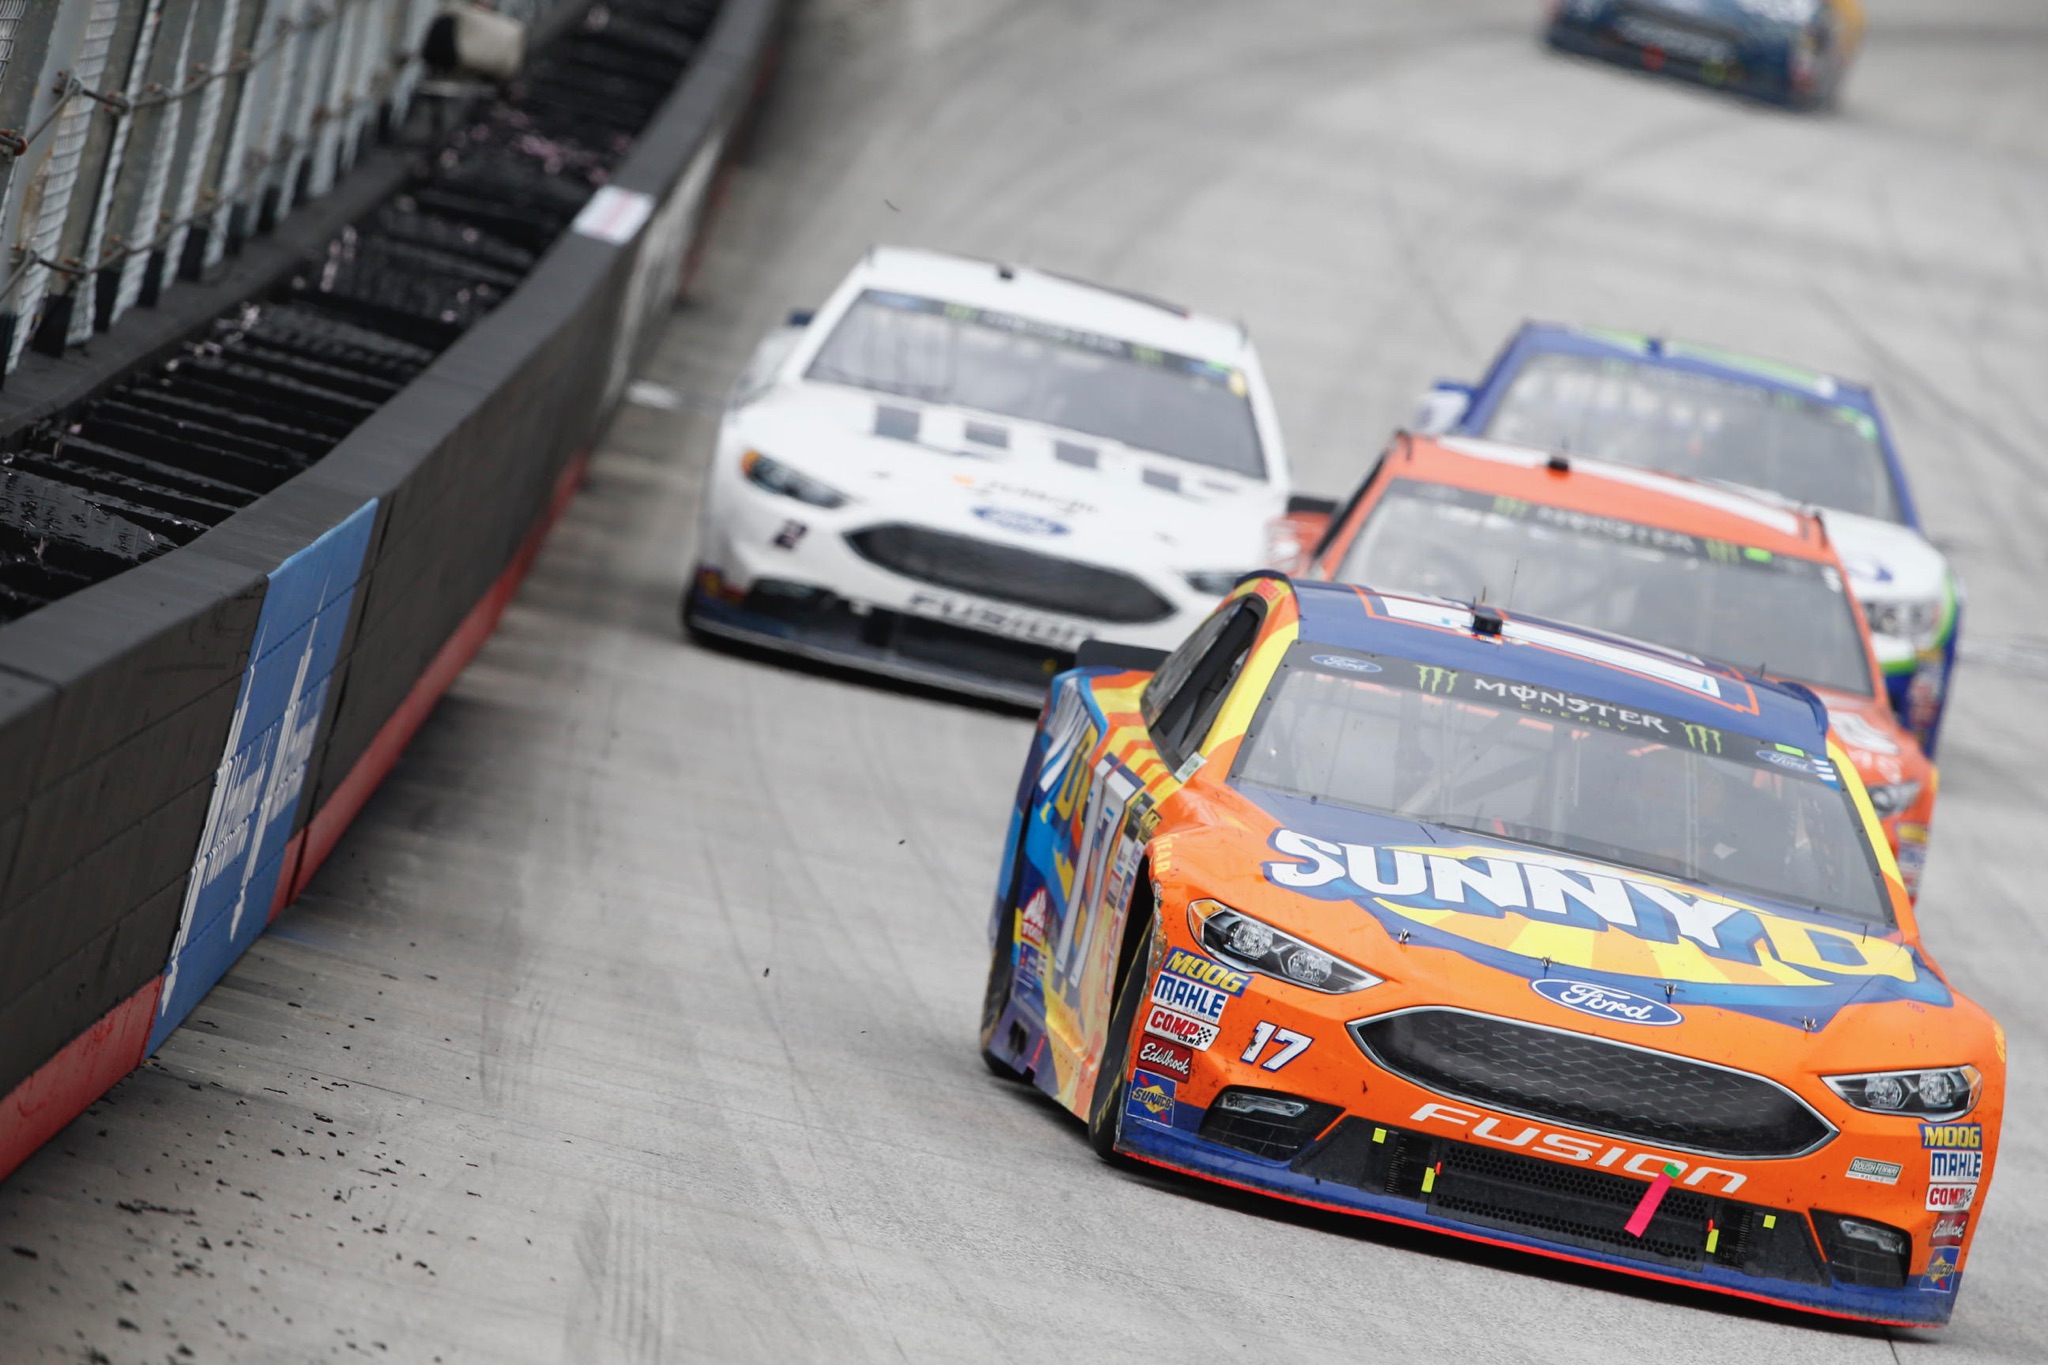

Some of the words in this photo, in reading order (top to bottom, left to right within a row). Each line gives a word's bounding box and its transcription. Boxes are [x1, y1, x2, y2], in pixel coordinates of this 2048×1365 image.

[1473, 676, 1669, 734] MONSTER
[1521, 703, 1629, 732] ENERGY
[1166, 950, 1250, 994] MOOG
[1152, 974, 1226, 1019] MAHLE
[1566, 981, 1653, 1023] Ford
[1150, 1010, 1200, 1037] COMP
[1139, 1042, 1190, 1075] Edelbrock
[1240, 1020, 1316, 1073] 17
[1409, 1103, 1748, 1194] FUSION
[1924, 1126, 1980, 1148] MOOG
[1931, 1152, 1981, 1177] MAHLE
